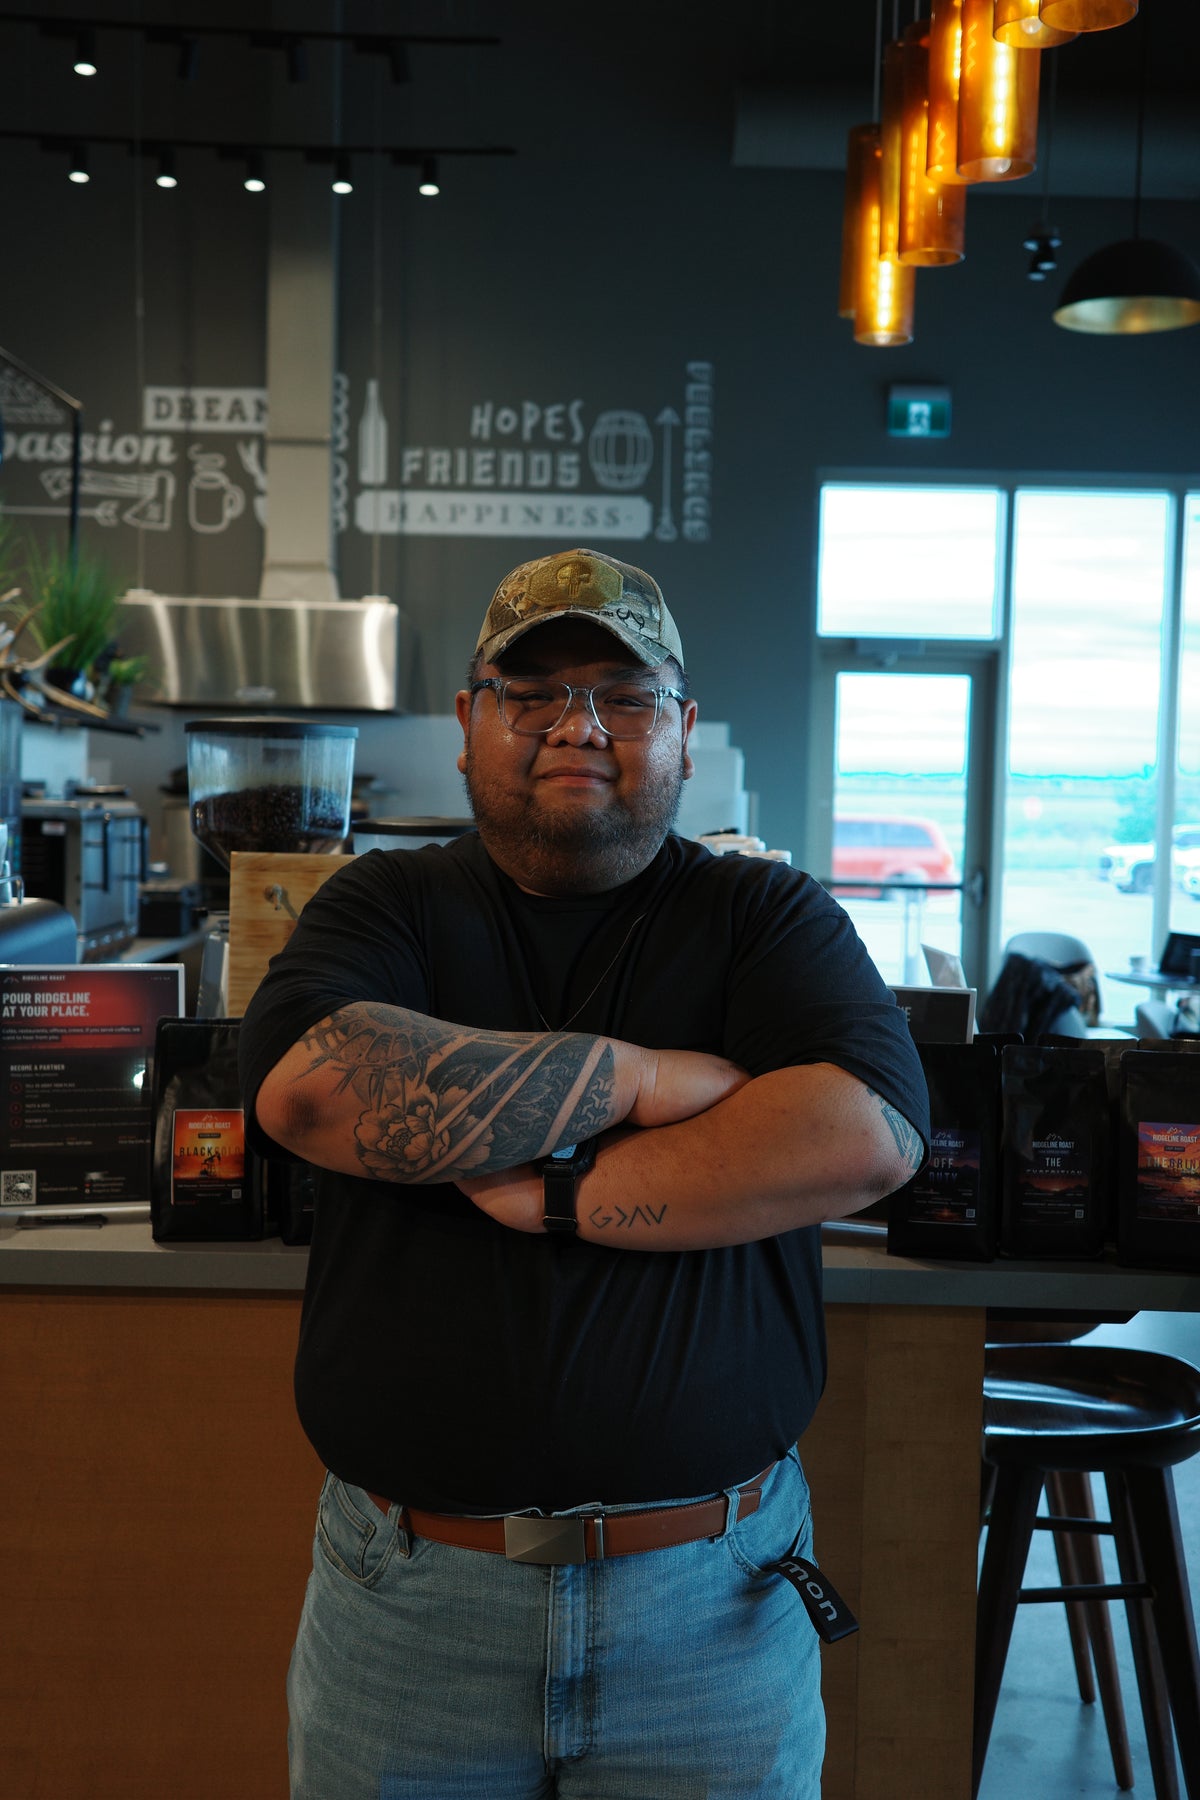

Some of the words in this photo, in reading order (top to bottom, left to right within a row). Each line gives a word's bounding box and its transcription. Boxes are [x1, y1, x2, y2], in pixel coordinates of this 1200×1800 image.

[471, 400, 585, 443] HOPES
[402, 447, 581, 487] FRIENDS
[388, 501, 621, 529] HAPPINESS
[2, 992, 32, 1004] POUR
[34, 992, 91, 1004] RIDGELINE
[2, 1006, 17, 1017] AT
[20, 1006, 49, 1017] YOUR
[51, 1005, 90, 1017] PLACE.
[1152, 1134, 1179, 1143] RIDGELINE
[1179, 1135, 1198, 1144] ROAST
[934, 1157, 954, 1168] OFF
[1045, 1157, 1062, 1167] THE
